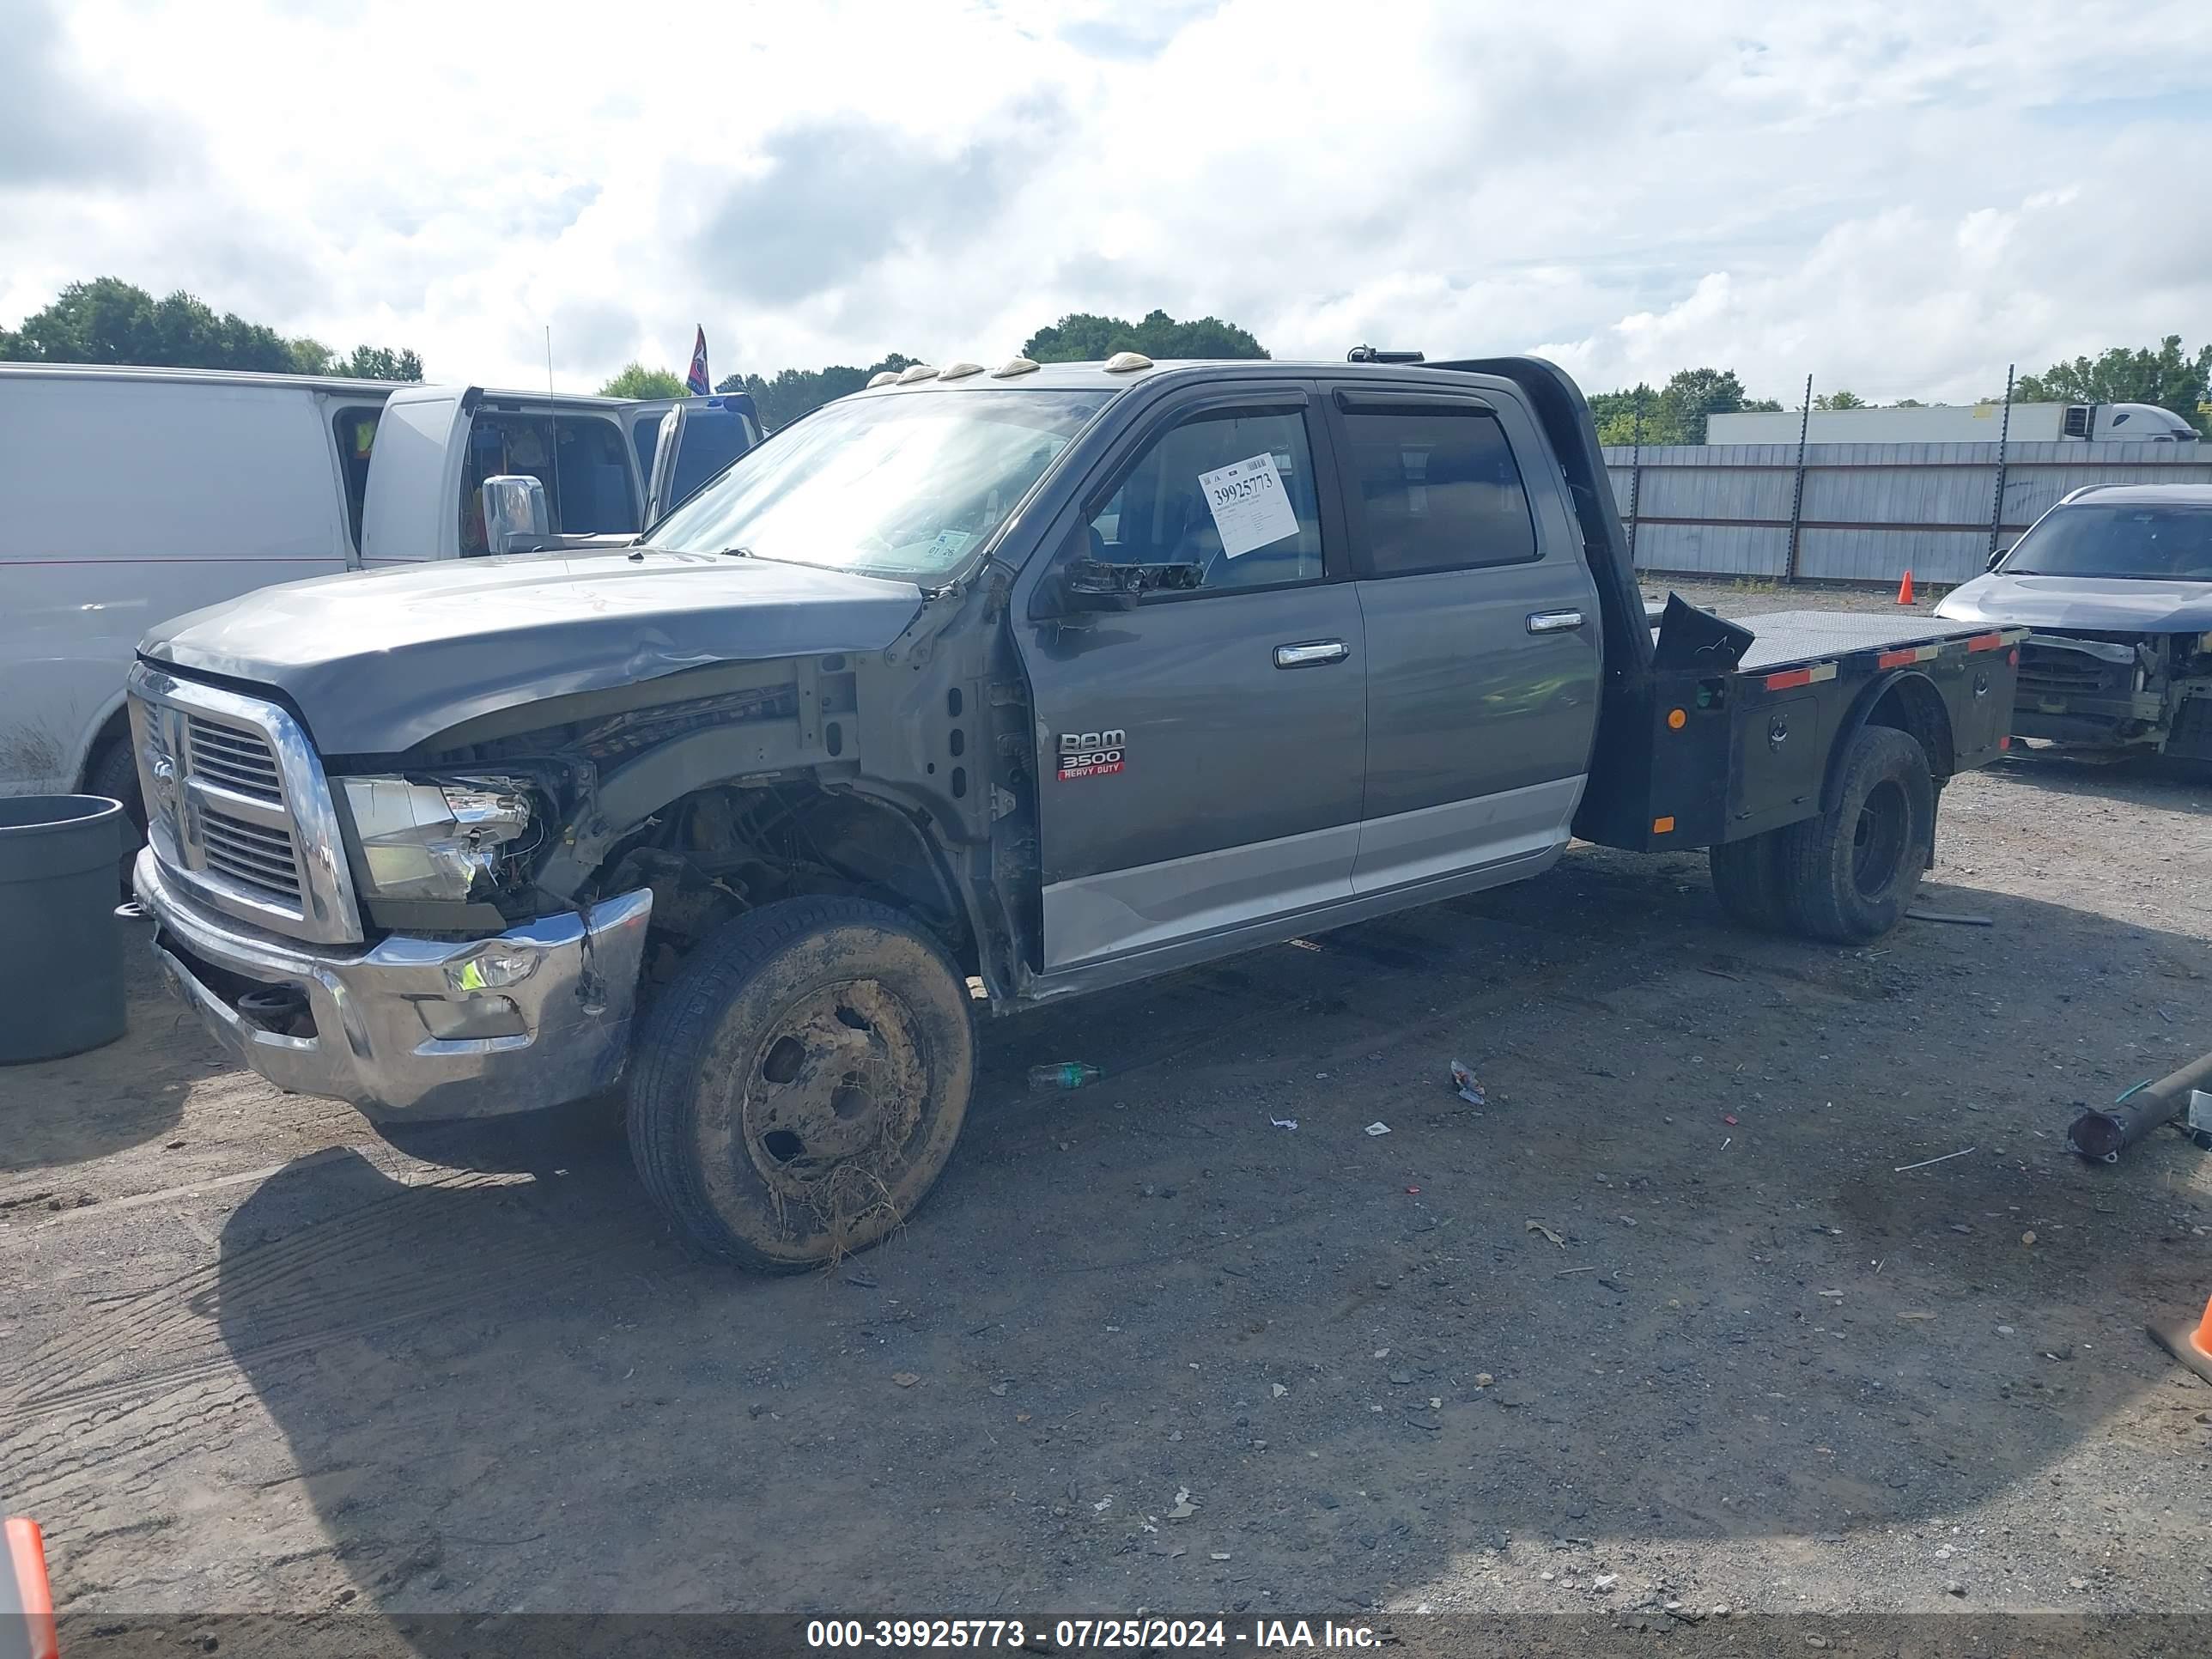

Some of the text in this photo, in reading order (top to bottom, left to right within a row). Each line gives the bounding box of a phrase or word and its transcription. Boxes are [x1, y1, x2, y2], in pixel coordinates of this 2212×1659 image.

[1213, 472, 1273, 506] 39925773
[1060, 729, 1126, 751] RAM
[1063, 751, 1121, 769] 3500
[1065, 763, 1120, 779] HEAVY DUTY
